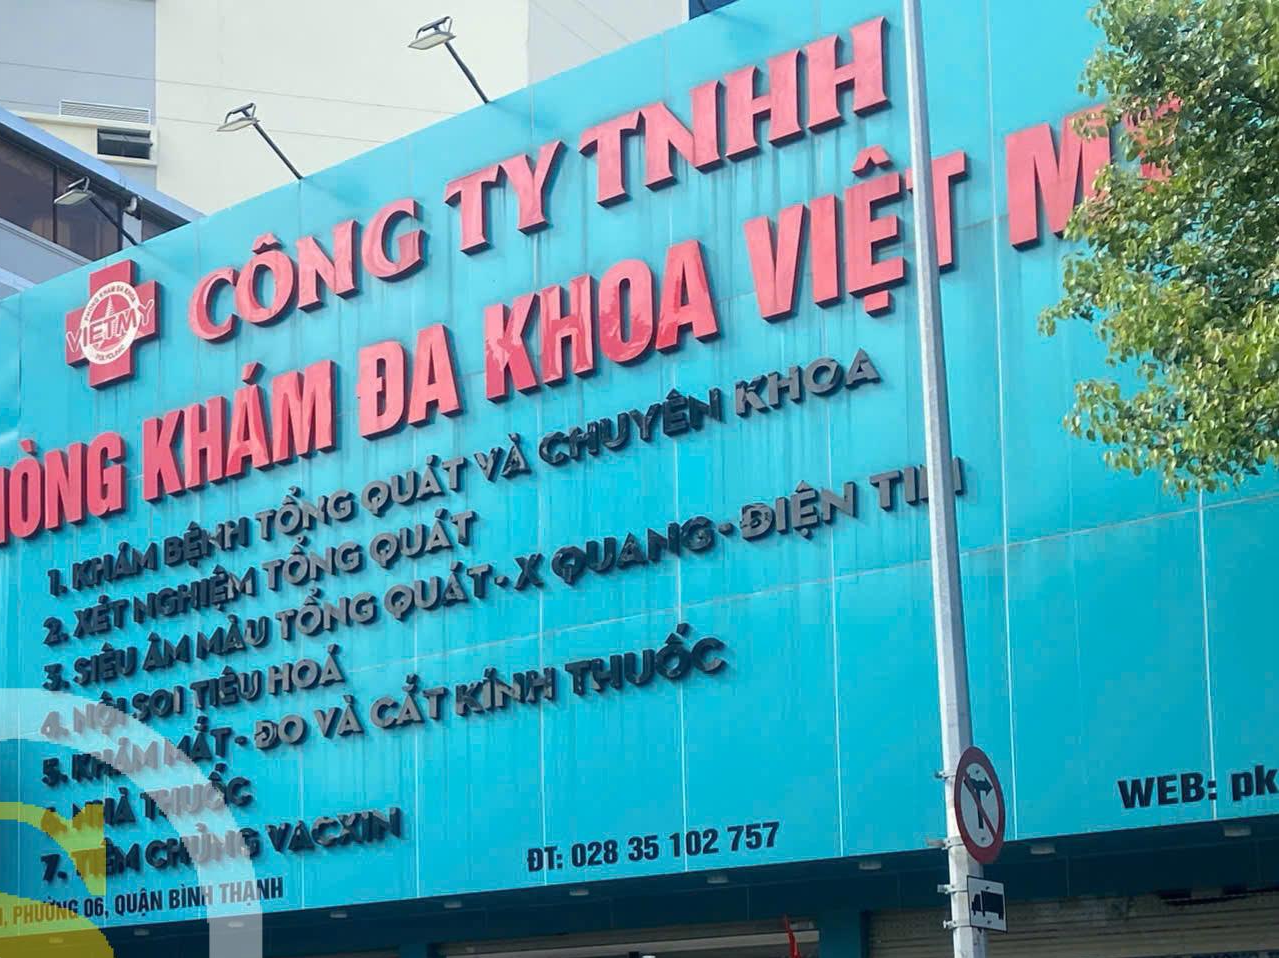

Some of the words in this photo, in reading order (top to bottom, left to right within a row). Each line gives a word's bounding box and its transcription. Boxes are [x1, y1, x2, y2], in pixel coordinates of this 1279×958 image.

[189, 198, 427, 343] CÔNG
[444, 140, 564, 255] TY
[578, 16, 889, 207] TNHH
[142, 360, 337, 502] KHÁM
[357, 322, 463, 440] ĐA
[484, 240, 719, 402] KHOA
[744, 146, 968, 320] VIỆT
[72, 542, 158, 590] KHÁM
[164, 521, 249, 568] BỆNH
[256, 486, 353, 541] TỔNG
[361, 454, 466, 515] QUÁT
[474, 433, 532, 481] VÀ
[538, 388, 725, 466] CHUYÊN
[733, 348, 882, 419] KHOA
[73, 595, 125, 636] XÉT
[133, 565, 257, 622] NGHIỆM
[262, 536, 362, 590] TỔNG
[369, 509, 476, 569] QUÁT
[74, 643, 137, 685] SIÊU
[142, 632, 193, 672] ÂM
[275, 587, 377, 642] TỔNG
[190, 664, 262, 712] TIÊU
[254, 713, 308, 750] ĐO
[314, 694, 364, 738] VÀ
[369, 673, 448, 730] CẮT
[455, 667, 557, 716] KÍNH
[565, 622, 727, 697] THUỐC
[1117, 772, 1218, 809] WEB:
[83, 898, 110, 919] 06,
[114, 890, 161, 917] QUẬN
[168, 884, 213, 910] BÌNH
[218, 875, 285, 906] THẠNH
[527, 846, 564, 873] ĐT:
[570, 838, 619, 868] 028
[627, 834, 660, 861] 35
[669, 828, 719, 858] 102
[726, 821, 781, 852] 757
